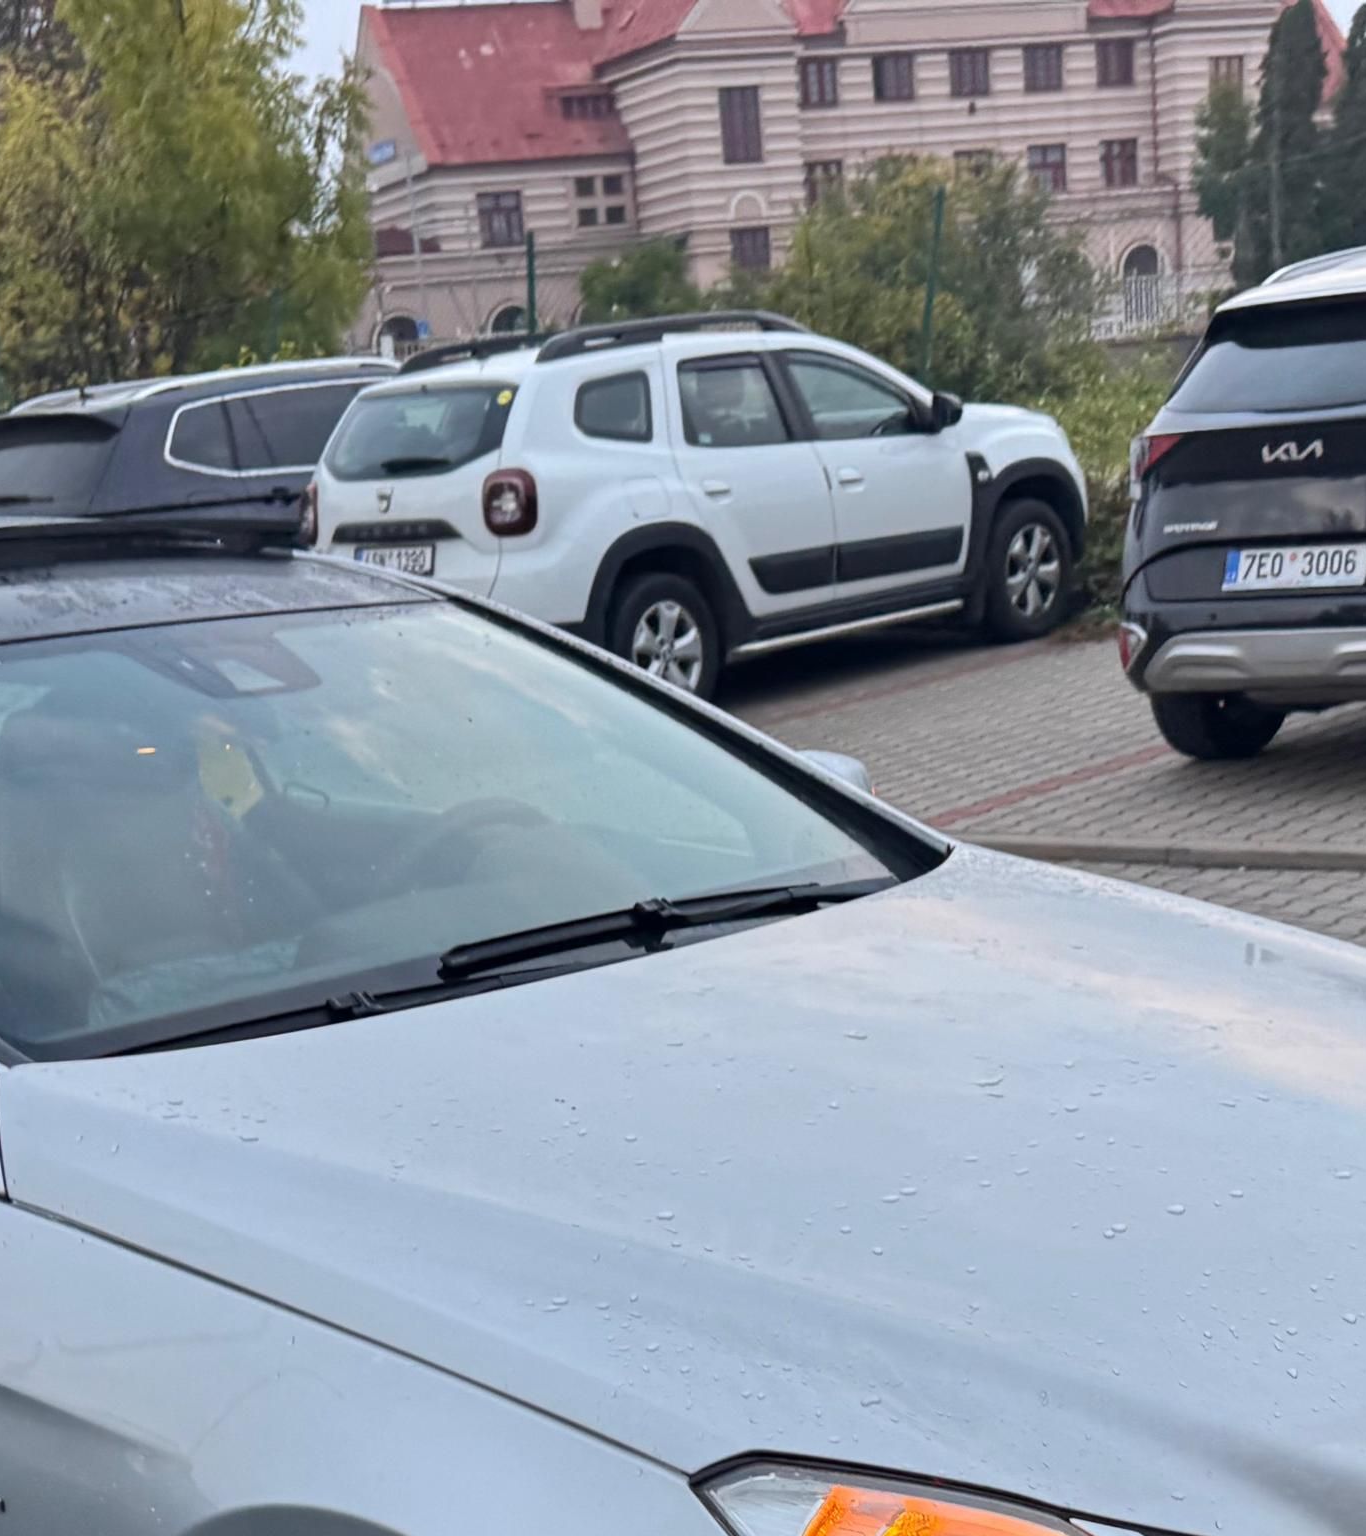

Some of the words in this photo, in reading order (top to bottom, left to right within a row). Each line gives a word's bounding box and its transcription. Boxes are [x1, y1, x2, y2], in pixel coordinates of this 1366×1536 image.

[1261, 439, 1324, 463] KIA
[1242, 552, 1284, 580] 7E0
[1300, 549, 1357, 577] 3006
